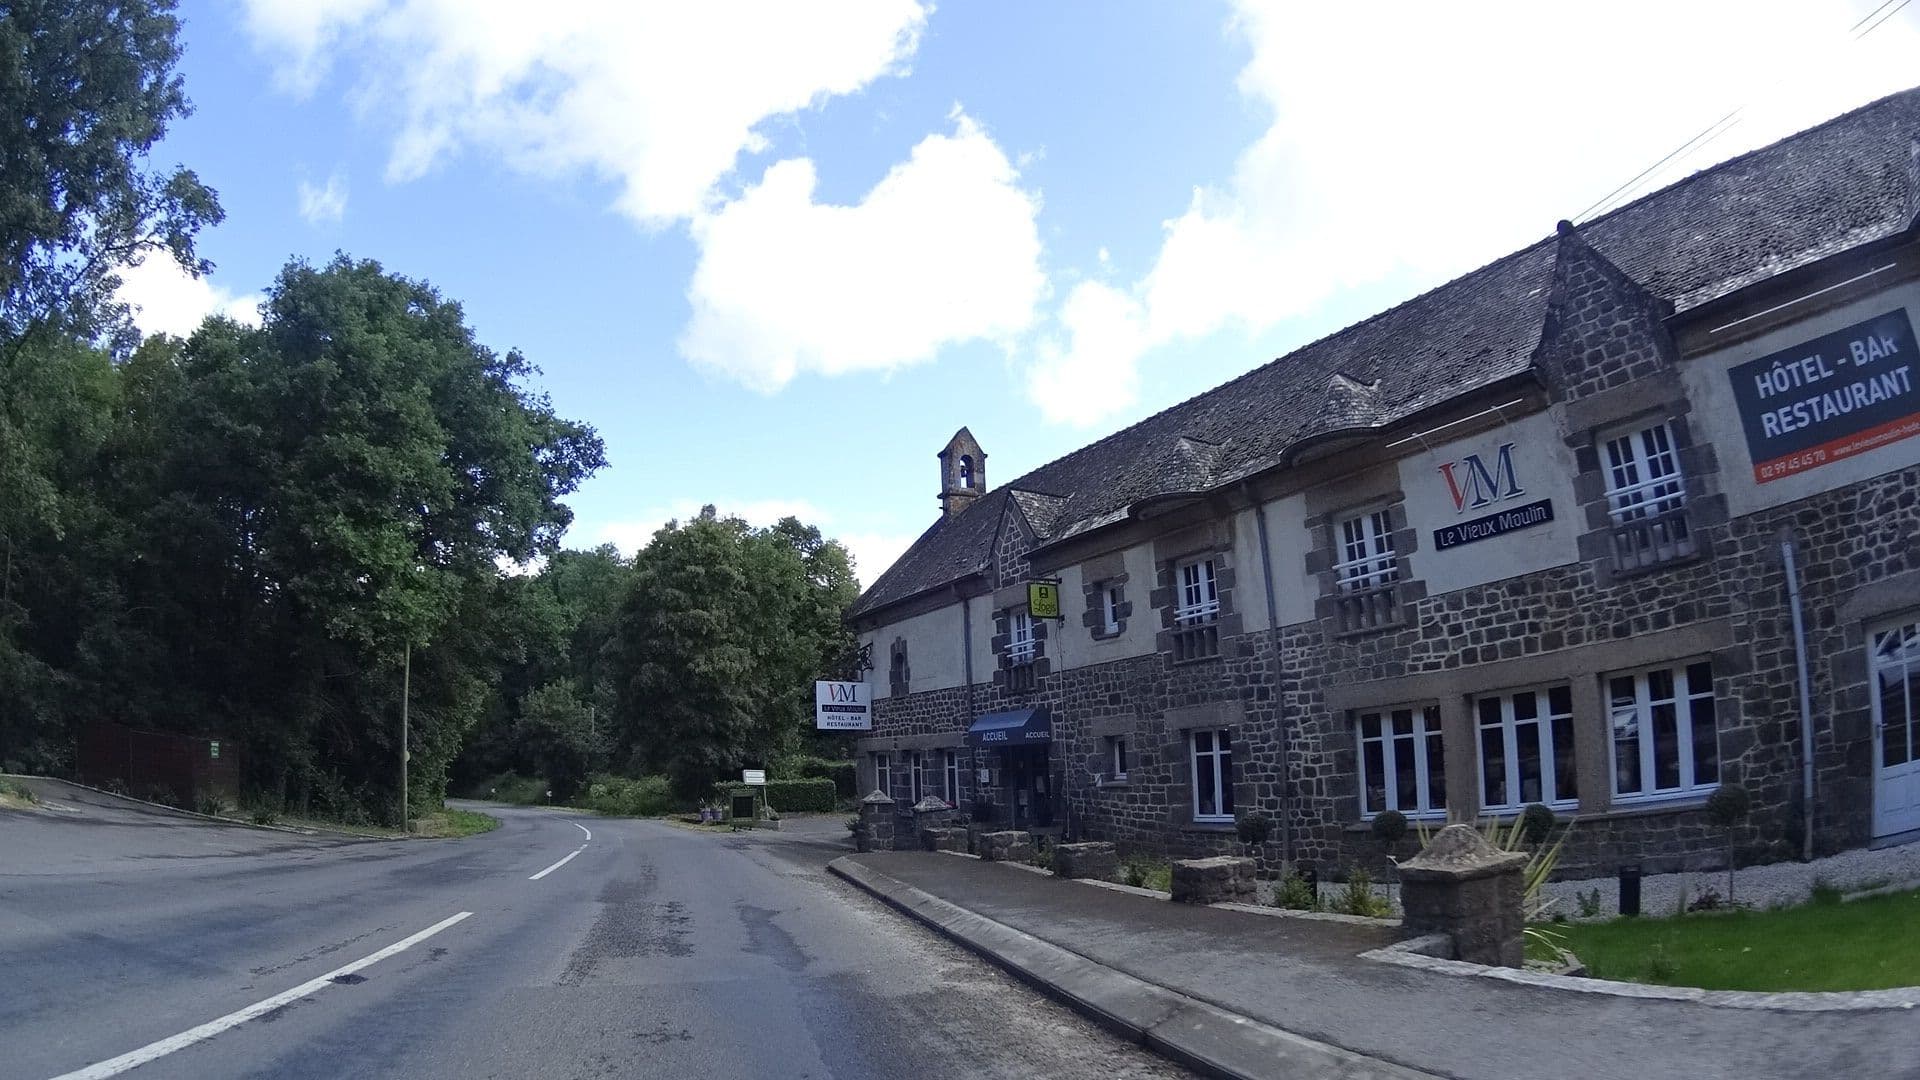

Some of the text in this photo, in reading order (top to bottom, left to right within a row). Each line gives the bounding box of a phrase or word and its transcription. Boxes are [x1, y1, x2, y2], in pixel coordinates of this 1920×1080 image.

[1754, 354, 1834, 399] HÔTEL
[1850, 335, 1898, 367] BAR
[1760, 366, 1912, 438] RESTAURANT
[1438, 442, 1526, 515] VM
[1440, 505, 1547, 546] Le Vieux Moulin
[828, 683, 858, 703] VM
[982, 730, 1008, 742] ACCUEIL
